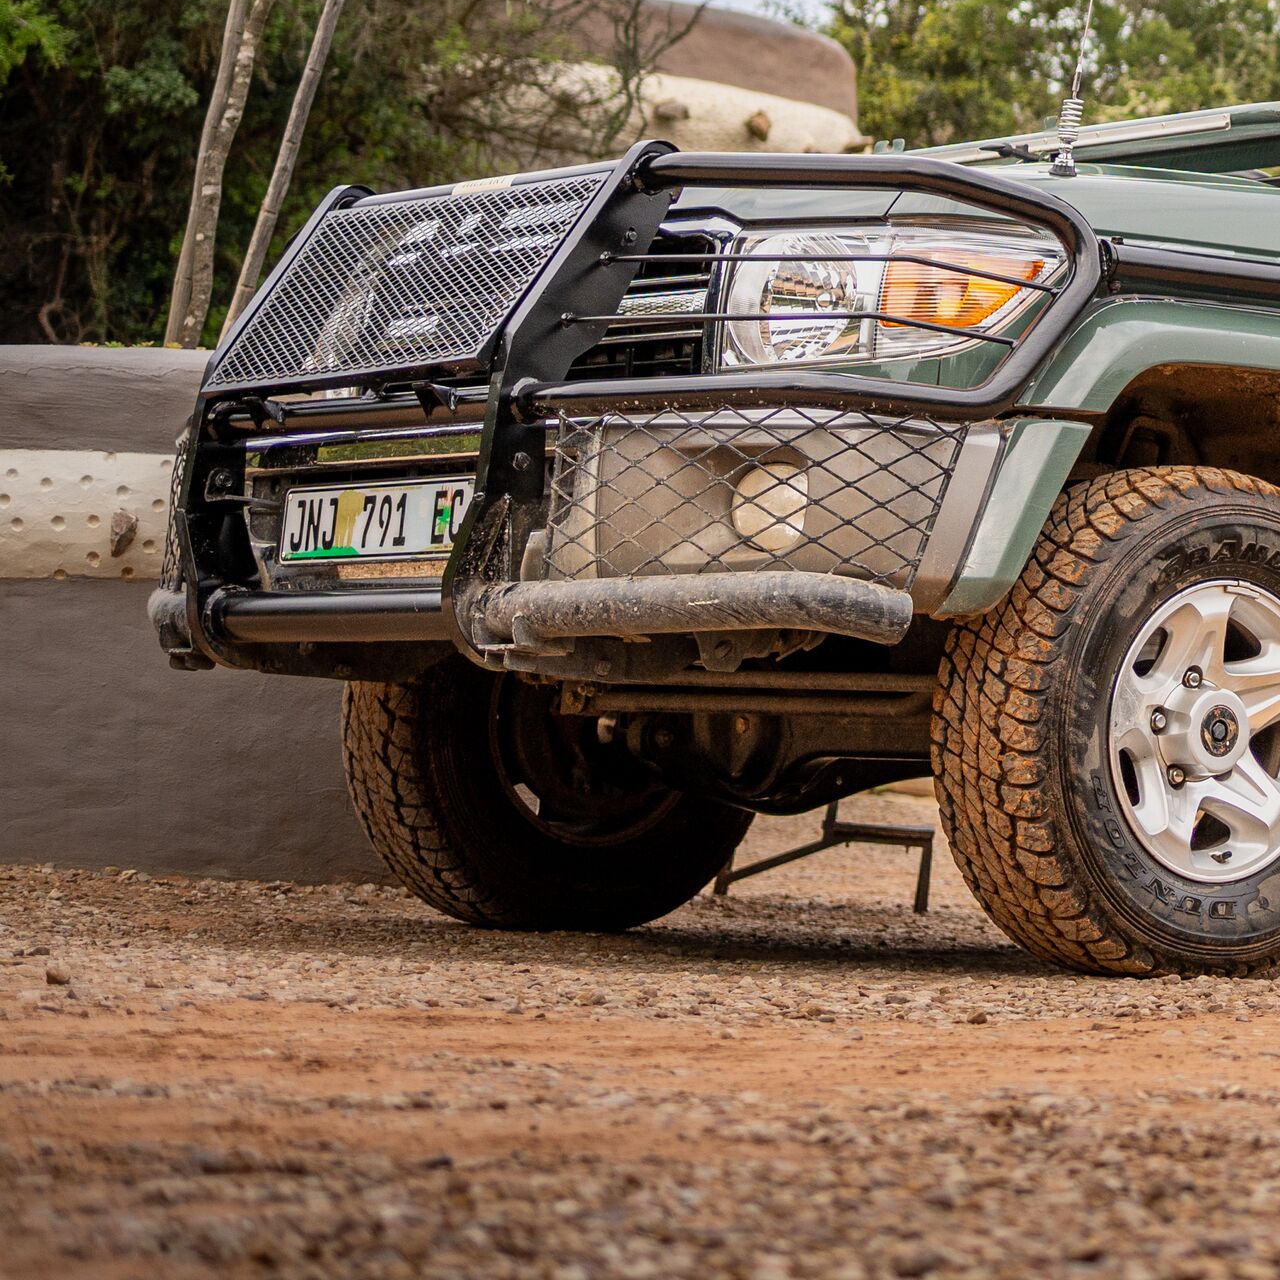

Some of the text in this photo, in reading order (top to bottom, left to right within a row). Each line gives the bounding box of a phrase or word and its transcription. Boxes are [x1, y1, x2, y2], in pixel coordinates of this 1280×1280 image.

[290, 488, 465, 552] JNJ 791 EC
[1090, 776, 1238, 919] DUNLOP
